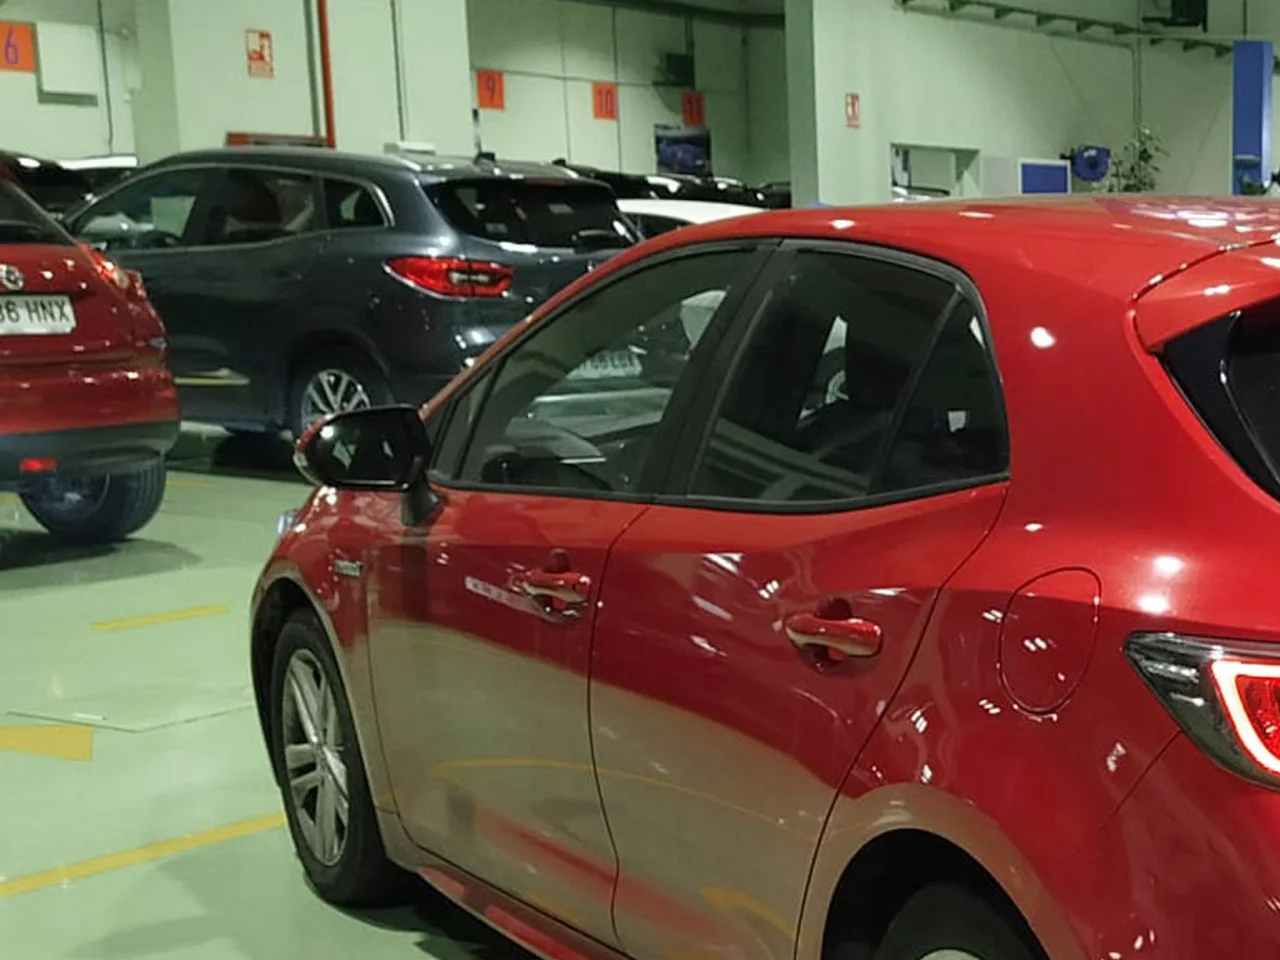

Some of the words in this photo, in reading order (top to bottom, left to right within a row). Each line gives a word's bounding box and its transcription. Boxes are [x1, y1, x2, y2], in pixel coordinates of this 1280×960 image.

[4, 25, 20, 65] 6
[485, 75, 497, 105] 9
[597, 87, 614, 115] 10
[25, 300, 70, 322] HNX
